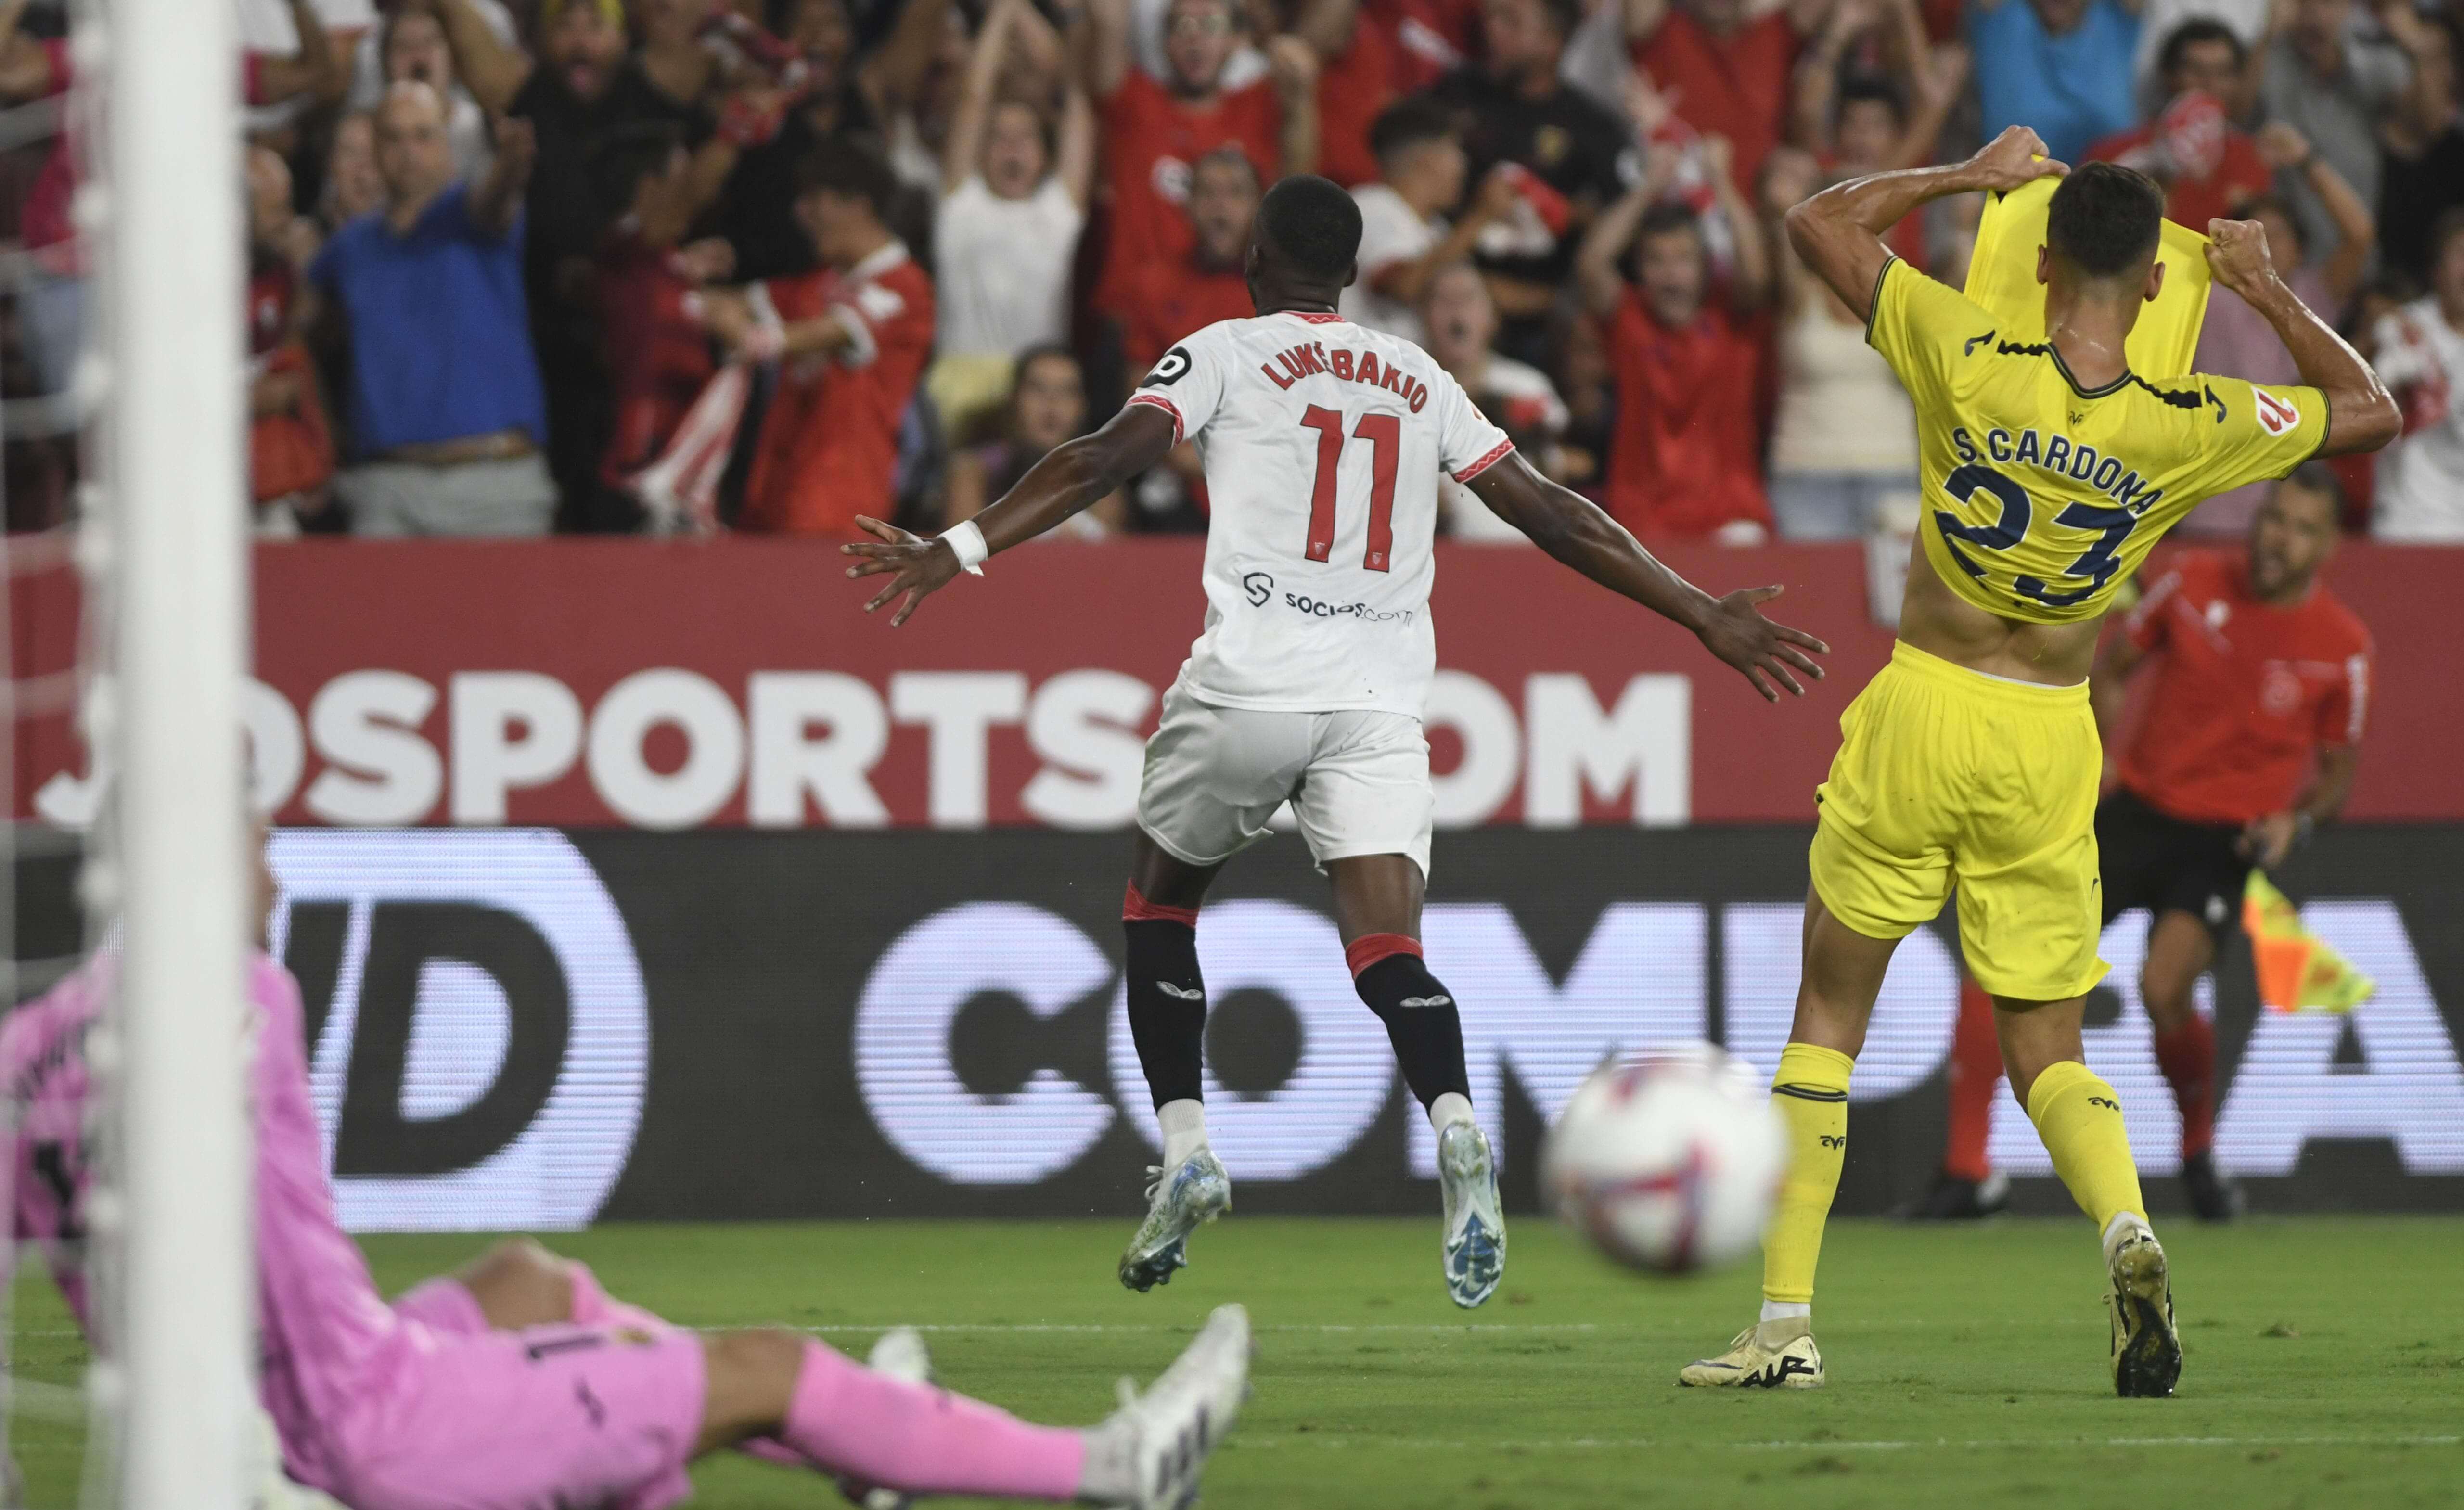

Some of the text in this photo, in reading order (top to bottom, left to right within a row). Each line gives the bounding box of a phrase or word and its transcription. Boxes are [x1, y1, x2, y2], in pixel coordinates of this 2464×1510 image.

[1300, 403, 1400, 573] 11
[1933, 462, 2138, 607] 23
[1952, 426, 2165, 520] S.CARDONA
